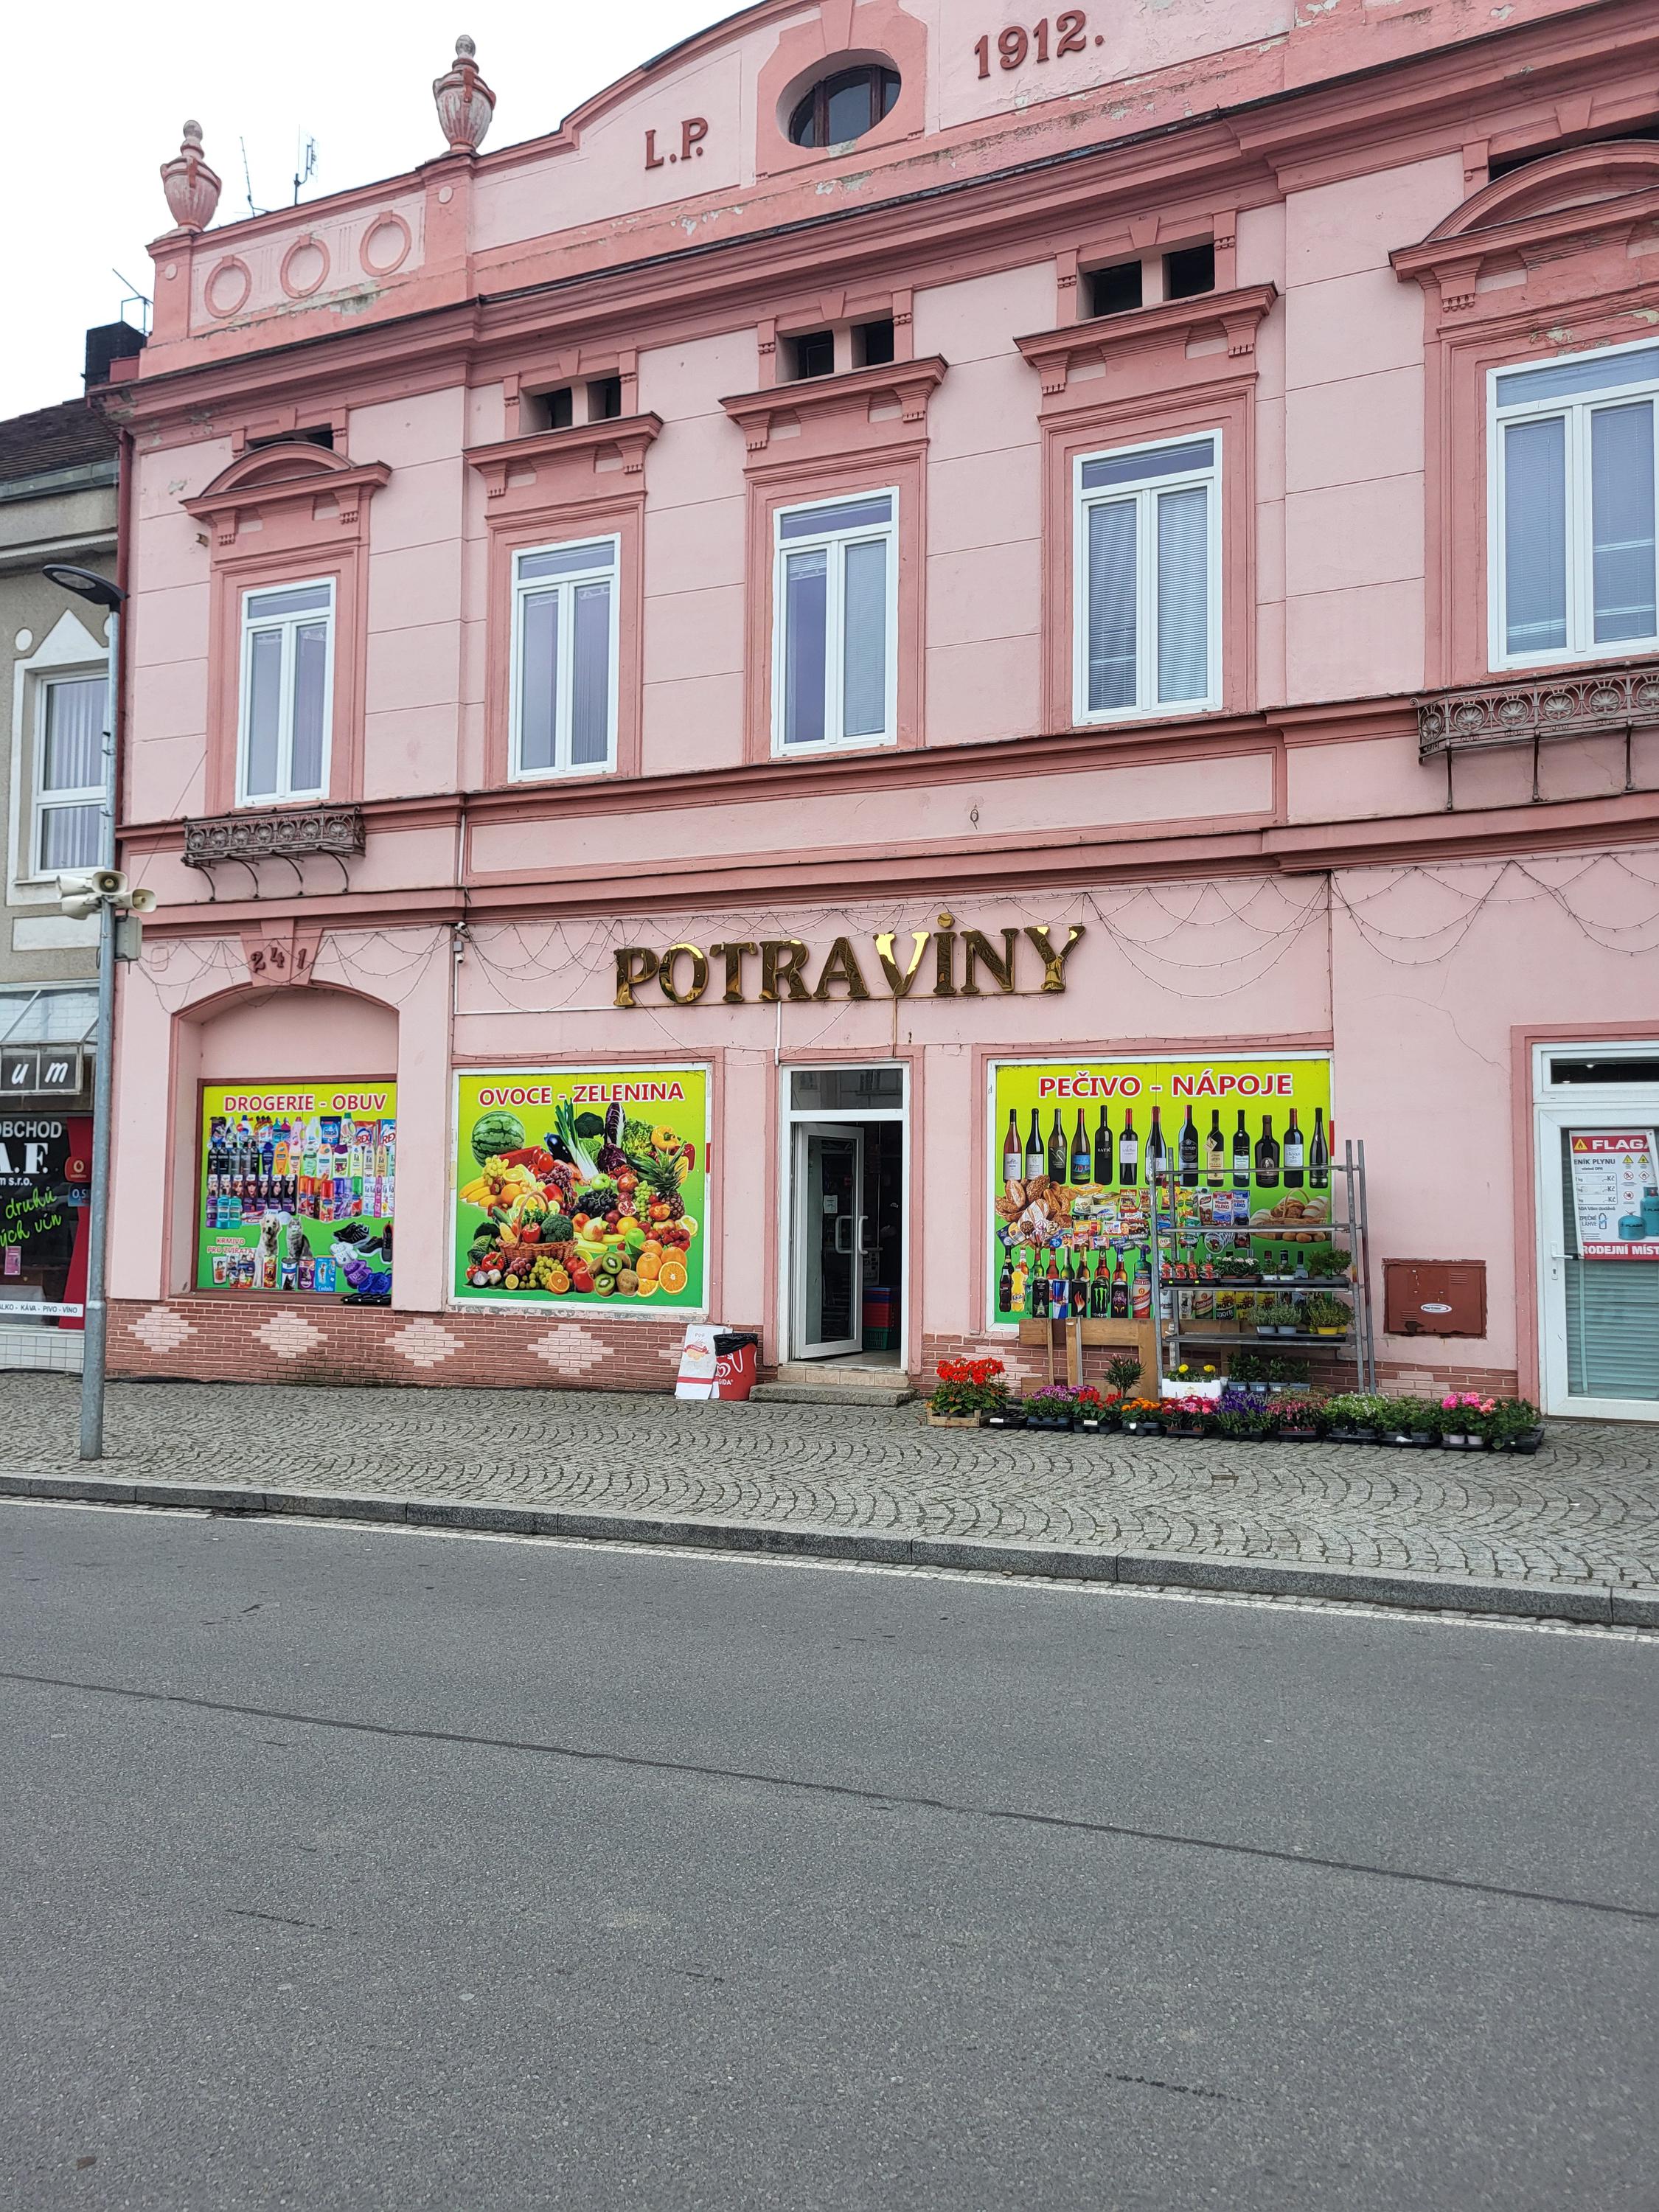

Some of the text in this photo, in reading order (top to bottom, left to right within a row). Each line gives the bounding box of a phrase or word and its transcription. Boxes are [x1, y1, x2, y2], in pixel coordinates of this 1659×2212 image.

[973, 10, 1104, 79] 1912.
[644, 116, 709, 170] L.P.
[251, 947, 307, 973] 241
[1040, 1072, 1141, 1097] PEČIVO
[1173, 1071, 1293, 1095] NÁPOJE
[225, 1095, 314, 1111] DROGERIE
[333, 1095, 386, 1110] OBUV
[479, 1088, 552, 1105] OVOCE
[573, 1083, 684, 1102] ZELENINA
[0, 1121, 62, 1138] BCHOD
[8, 1178, 33, 1186] s.r.o.
[1582, 1244, 1629, 1255] RODEJNÍ
[21, 1304, 37, 1312] KÁVA
[63, 1306, 77, 1314] VÍNO
